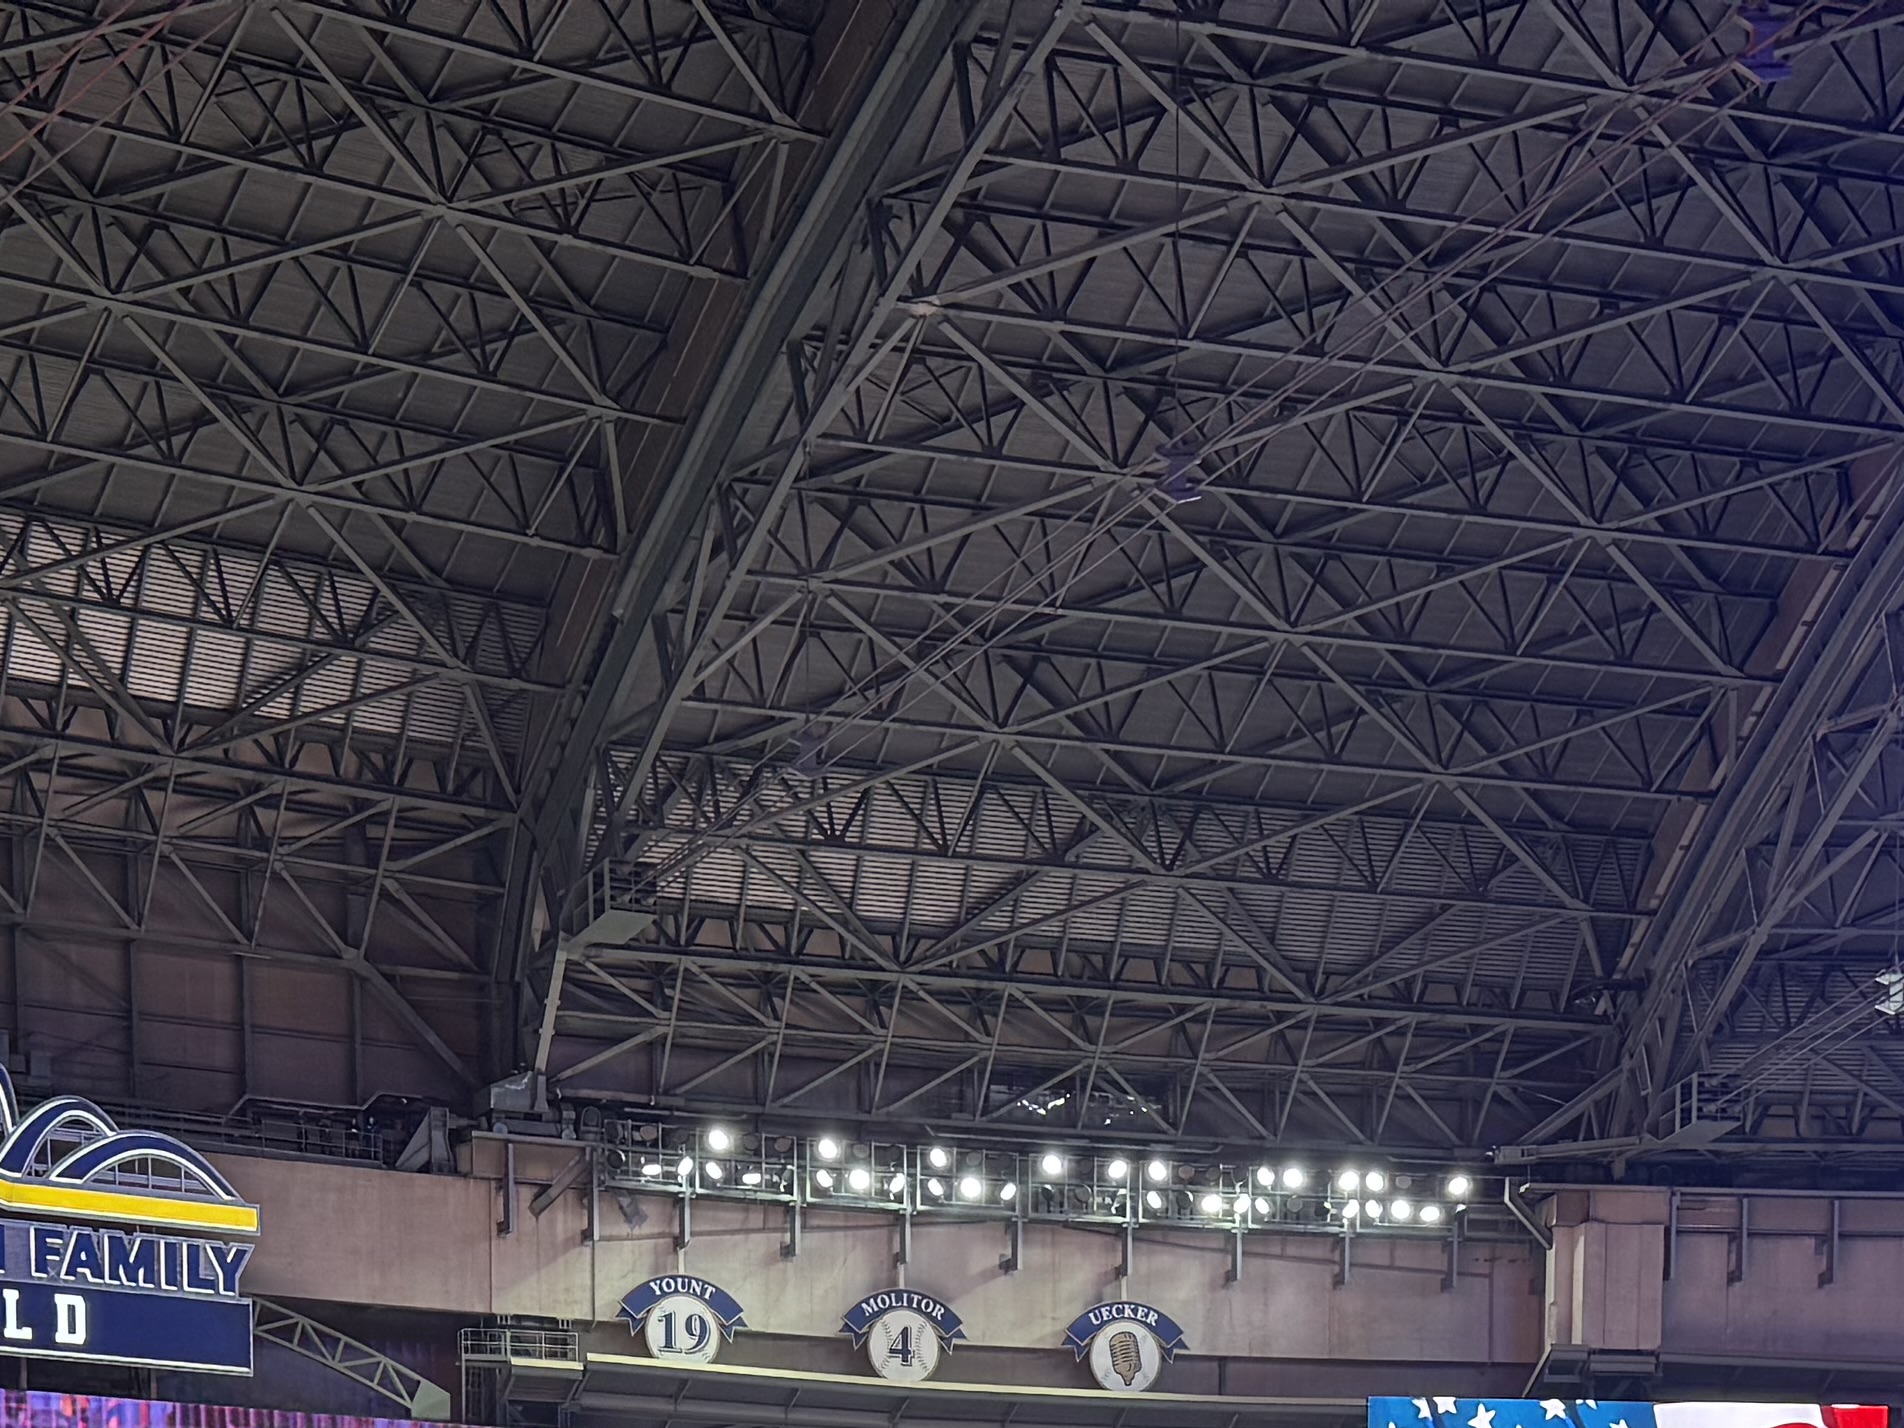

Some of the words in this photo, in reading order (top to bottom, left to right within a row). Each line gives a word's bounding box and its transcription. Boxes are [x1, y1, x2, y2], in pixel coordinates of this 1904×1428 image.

[32, 1224, 252, 1297] FAMILY
[648, 1278, 716, 1300] YOUNT
[862, 1292, 946, 1321] MOLITOR
[1088, 1303, 1158, 1327] UECKER
[657, 1311, 712, 1356] 19
[886, 1326, 917, 1367] 4
